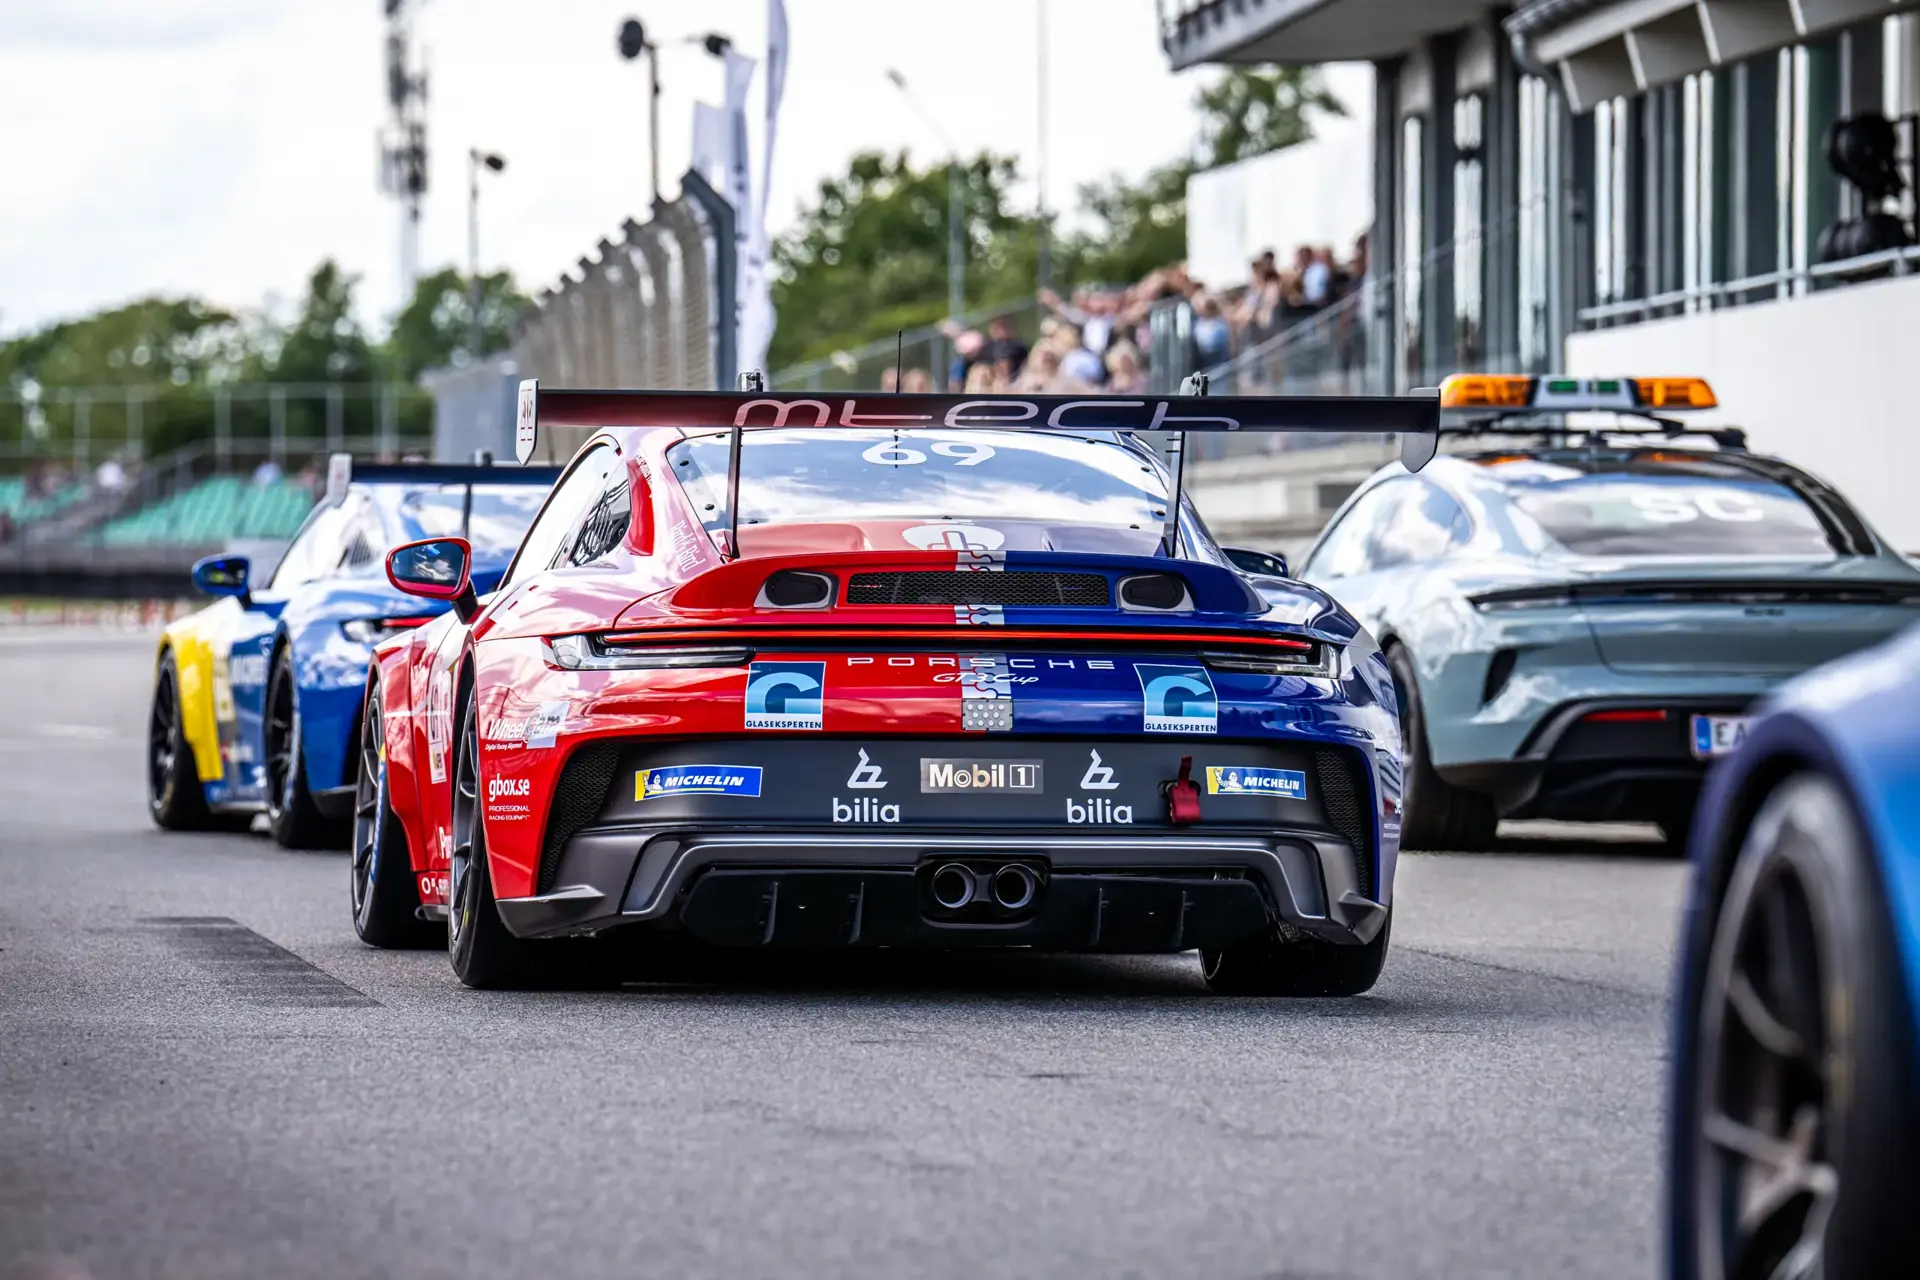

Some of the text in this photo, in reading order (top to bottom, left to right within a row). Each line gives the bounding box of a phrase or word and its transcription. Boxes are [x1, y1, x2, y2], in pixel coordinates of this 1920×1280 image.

[732, 399, 1240, 431] mtech
[862, 440, 995, 466] 69
[1631, 491, 1763, 522] SC
[847, 657, 1115, 669] PORSCHE
[992, 673, 1039, 685] Cup
[745, 720, 822, 729] GLASEKSPERTEN
[1145, 723, 1217, 732] GLASEKSPERTEN
[488, 773, 531, 802] gbox.se
[664, 775, 744, 787] MICHELIN
[929, 764, 1005, 788] Mobil
[1243, 776, 1300, 790] MICHELIN
[832, 797, 900, 823] bilia
[1066, 798, 1133, 824] bilia
